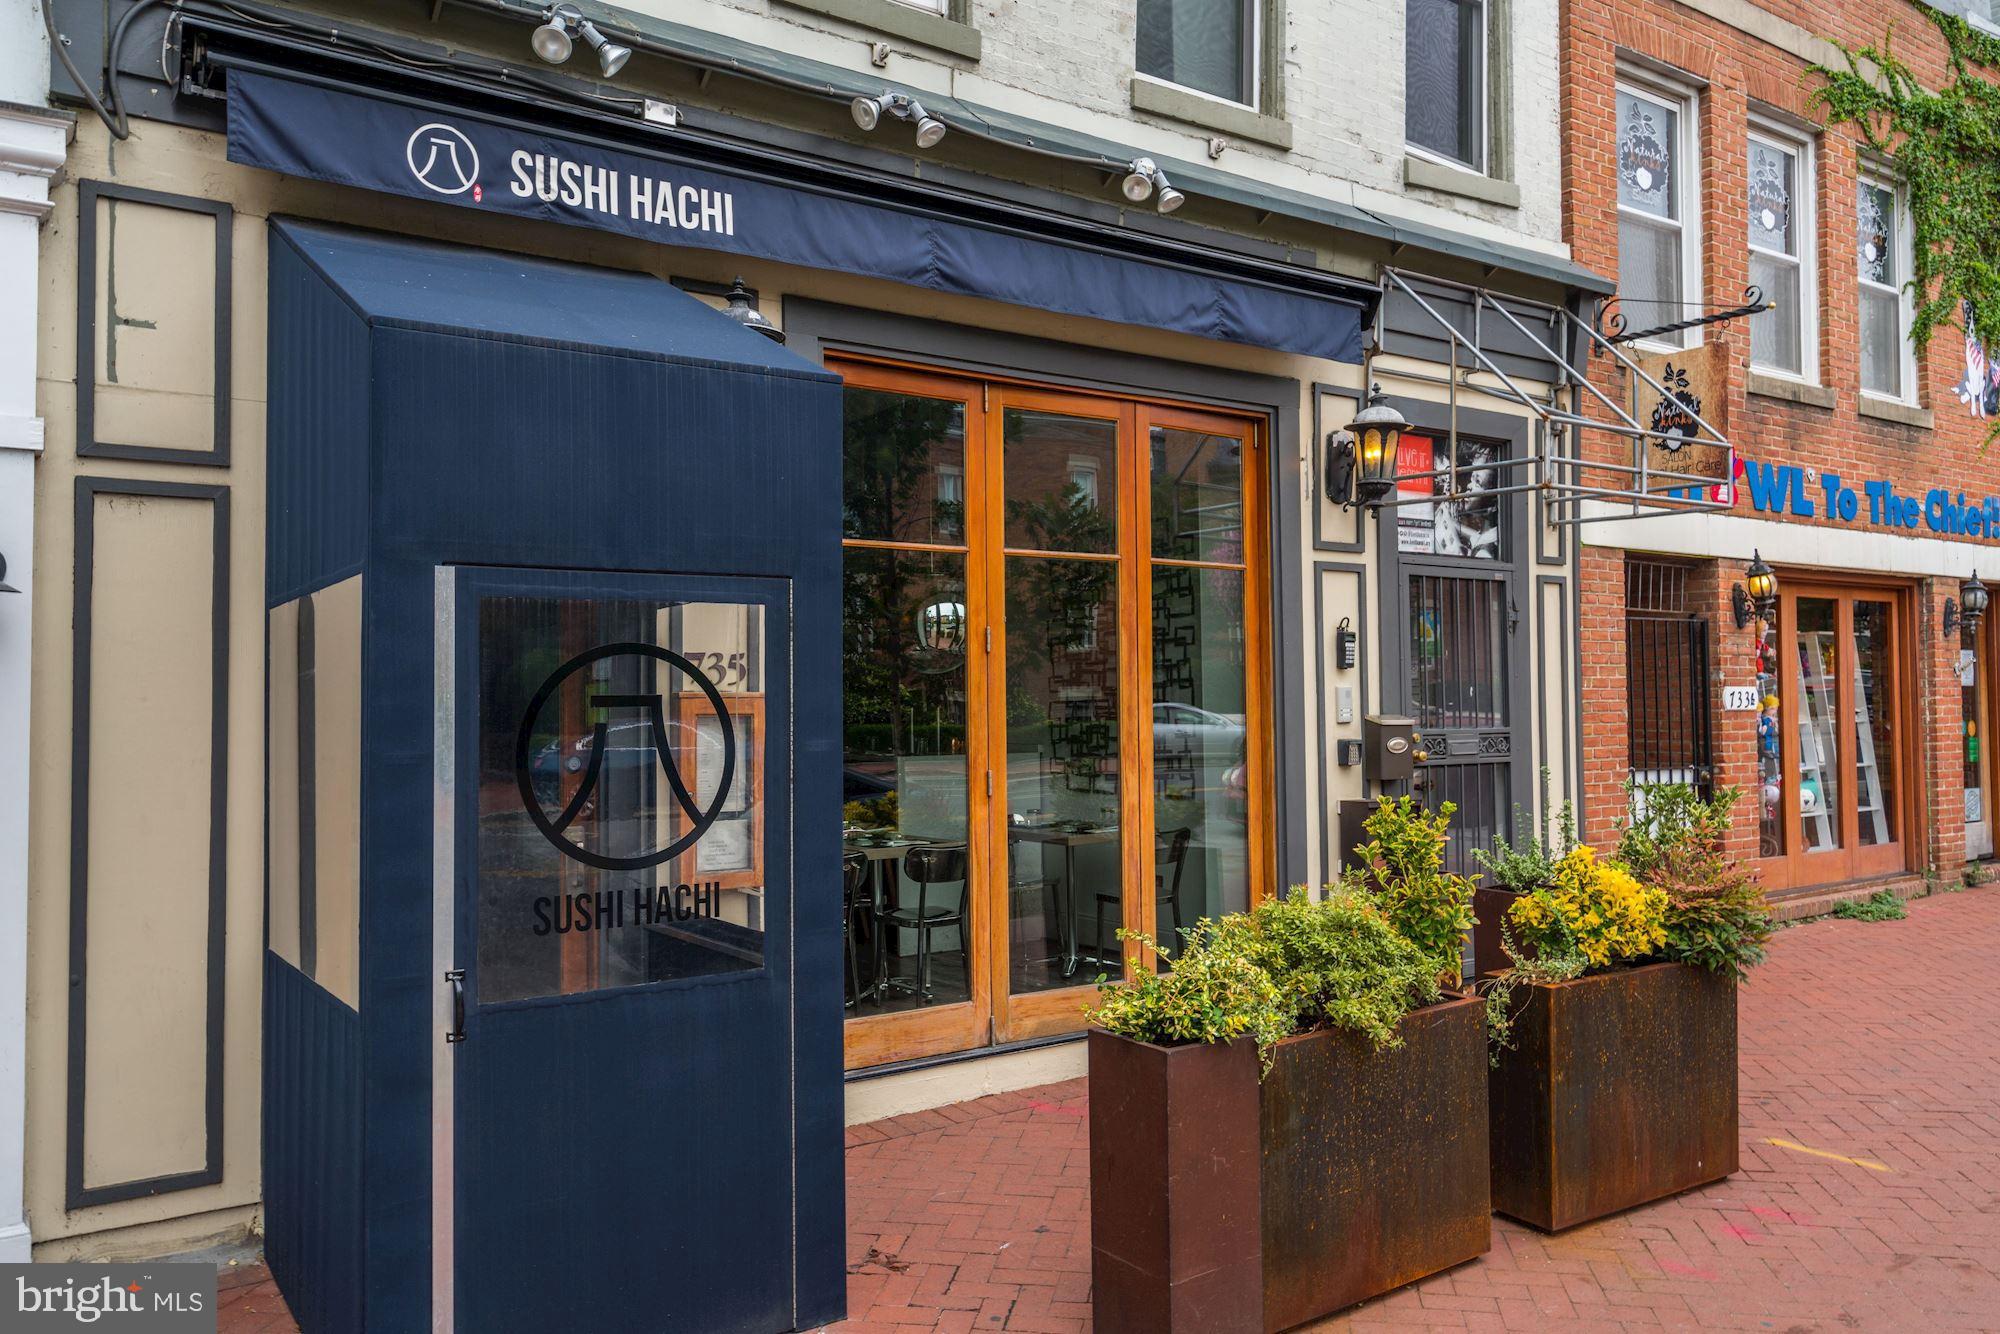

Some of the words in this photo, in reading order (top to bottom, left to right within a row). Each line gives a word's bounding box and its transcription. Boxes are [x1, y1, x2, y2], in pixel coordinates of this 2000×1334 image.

[510, 149, 619, 216] SUSHI
[630, 174, 734, 236] HACHI
[1654, 396, 1699, 419] Natual
[1662, 450, 1692, 465] SALON
[1695, 458, 1722, 473] Care
[1821, 473, 1858, 522] To
[1864, 480, 1920, 529] The
[683, 651, 747, 687] 735
[533, 889, 624, 936] SUSHI
[634, 881, 720, 926] HACHI
